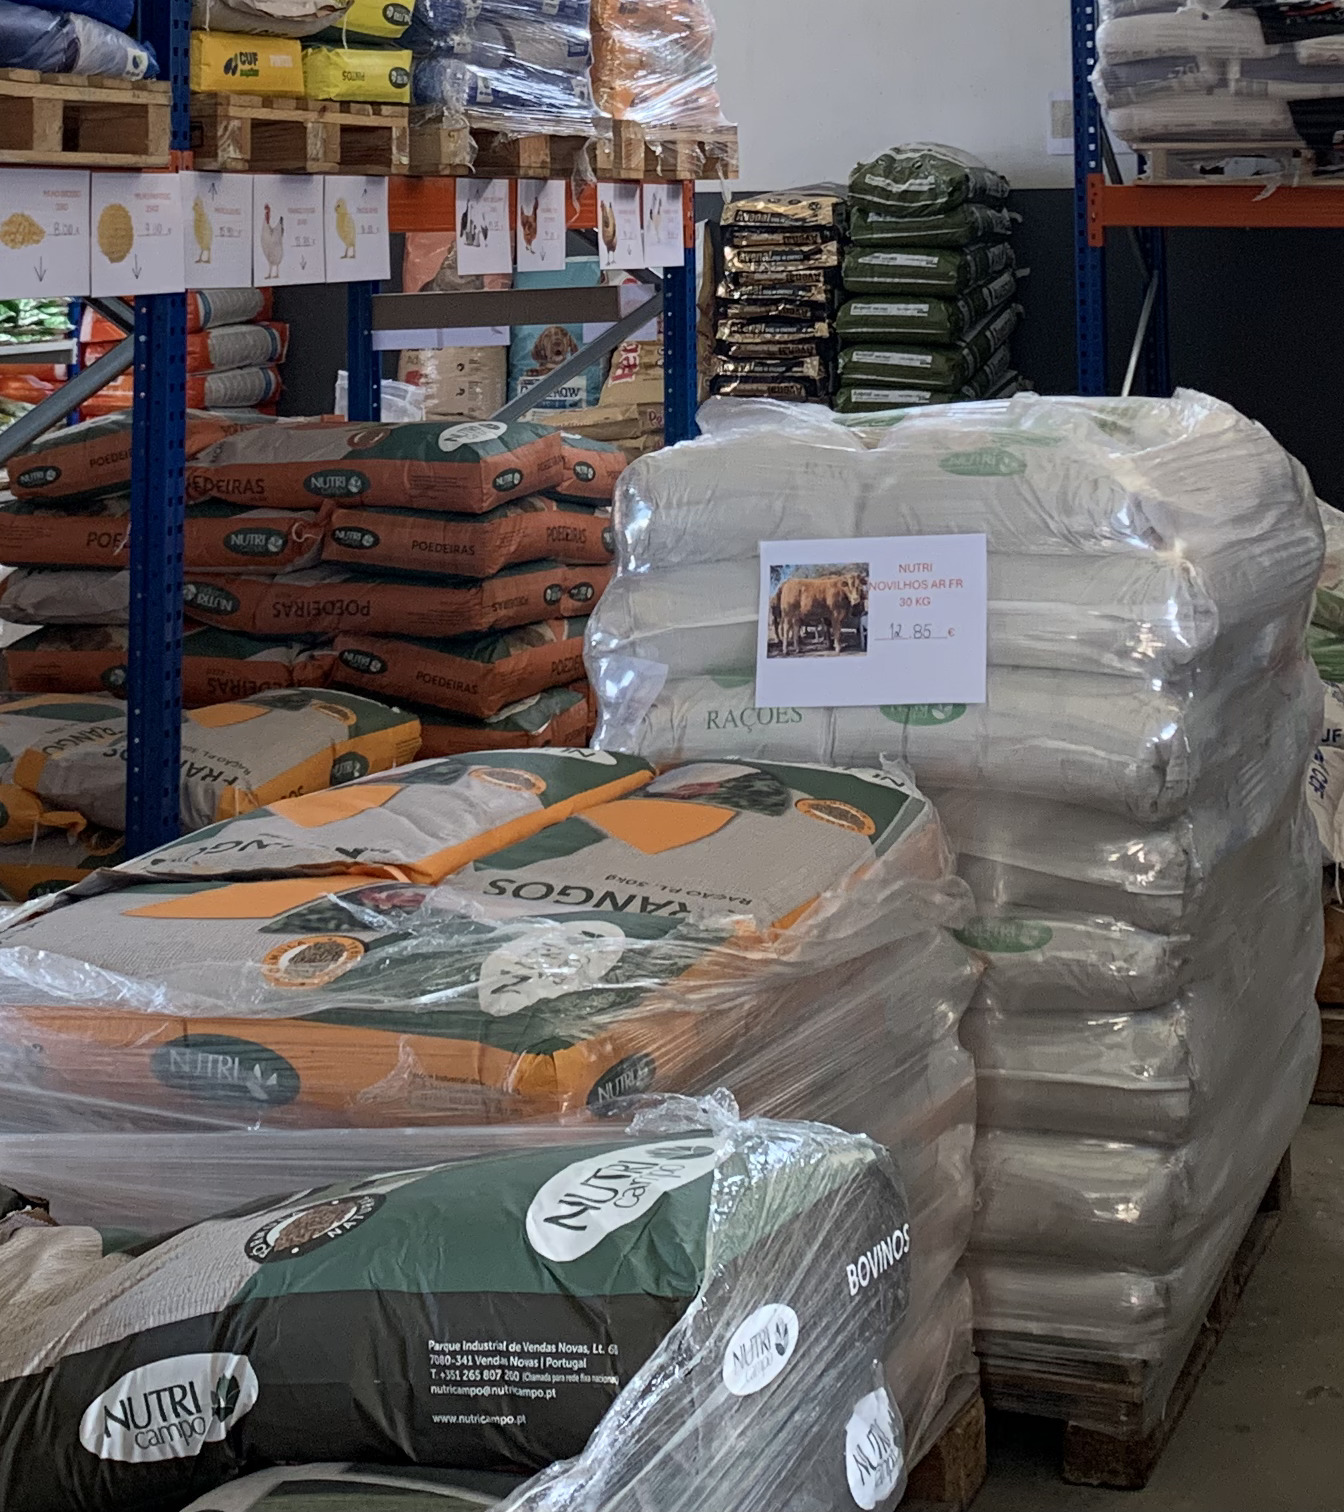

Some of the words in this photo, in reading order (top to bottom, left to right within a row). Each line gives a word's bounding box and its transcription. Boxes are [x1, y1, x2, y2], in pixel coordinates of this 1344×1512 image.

[735, 209, 771, 223] Avenal
[19, 471, 46, 485] NUTRI
[310, 476, 347, 491] NUTRI
[230, 532, 266, 548] NUTRI
[337, 529, 362, 542] NUTRI
[411, 539, 476, 557] POEDEIRAS
[898, 562, 933, 574] NUTRI
[869, 579, 929, 591] NOVILHOS
[931, 579, 946, 589] AR
[948, 578, 964, 589] FR
[193, 587, 234, 611] NUTRI
[899, 597, 913, 608] 30
[915, 596, 932, 607] KG
[272, 599, 372, 619] POEDEIRAS
[415, 669, 479, 696] POEDEIRAS
[168, 1047, 242, 1076] NUTRI
[598, 1068, 640, 1102] NUTRI
[613, 1163, 685, 1210] campo
[542, 1160, 656, 1232] NUTRI
[845, 1223, 911, 1297] BOVINOS
[428, 1340, 461, 1354] Parque
[462, 1340, 507, 1352] Industrial
[509, 1341, 522, 1353] de
[523, 1342, 557, 1354] Vendas
[558, 1342, 591, 1355] Novas,
[592, 1344, 606, 1355] Lt.
[731, 1327, 772, 1377] NUTRI
[429, 1354, 474, 1367] 7080-341
[475, 1355, 509, 1367] Vendas
[510, 1356, 539, 1369] Novas
[546, 1357, 588, 1372] Portugal
[430, 1368, 439, 1380] T.
[439, 1369, 461, 1381] +351
[462, 1370, 482, 1381] 265
[483, 1370, 503, 1381] 807
[522, 1372, 552, 1383] (Chamada
[552, 1374, 566, 1384] para
[566, 1373, 580, 1383] rede
[430, 1384, 557, 1401] nutricampo@nutricampo.pt
[104, 1381, 202, 1439] NUTRI
[432, 1413, 527, 1427] www.nutricampo.pt
[134, 1415, 207, 1451] campo
